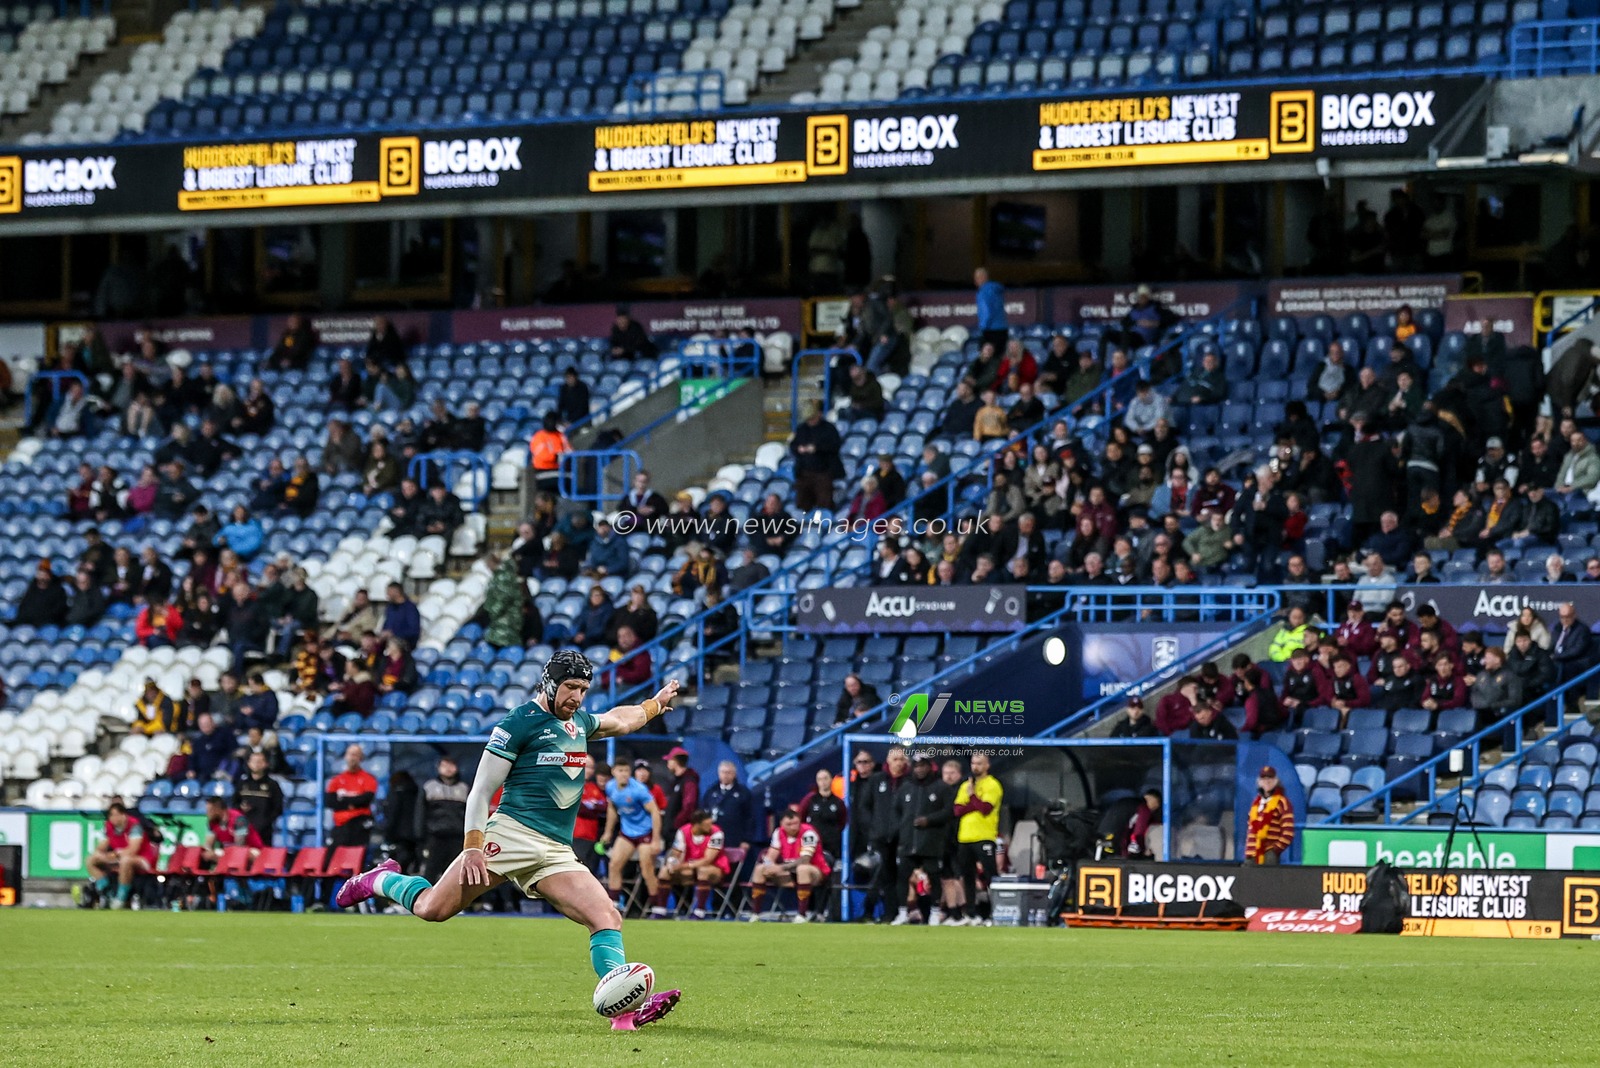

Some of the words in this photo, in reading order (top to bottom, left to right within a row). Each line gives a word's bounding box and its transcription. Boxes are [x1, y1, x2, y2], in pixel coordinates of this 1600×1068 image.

[1039, 96, 1171, 126] HUDDERSFIELD'S
[1171, 92, 1241, 120] NEWEST
[1321, 90, 1435, 131] BIGBOX
[595, 120, 716, 149] HUDDERSFIELD'S
[716, 117, 781, 144] NEWEST
[853, 114, 959, 153] BIGBOX
[1039, 126, 1054, 149] &
[1055, 121, 1122, 149] BIGGEST
[1123, 118, 1190, 146] LEISURE
[1191, 116, 1236, 142] CLUB
[1321, 127, 1409, 147] HUDDERSFIELD
[296, 138, 358, 165] NEWEST
[423, 136, 522, 175] BIGBOX
[594, 148, 608, 172] &
[609, 144, 671, 172] BIGGEST
[672, 142, 735, 169] LEISURE
[735, 140, 777, 166] CLUB
[24, 155, 117, 193] BIGBOX
[314, 161, 354, 185] CLUB
[540, 754, 567, 763] home
[1376, 841, 1516, 869] heatable
[1128, 873, 1236, 903] BIGBOX
[1460, 873, 1532, 897] NEWEST
[1261, 908, 1363, 926] GLEN'S
[1321, 893, 1336, 912] &
[1411, 895, 1479, 918] LEISURE
[1482, 896, 1527, 919] CLUB
[1266, 923, 1337, 933] VODKA
[604, 983, 646, 1016] STEEDEN
